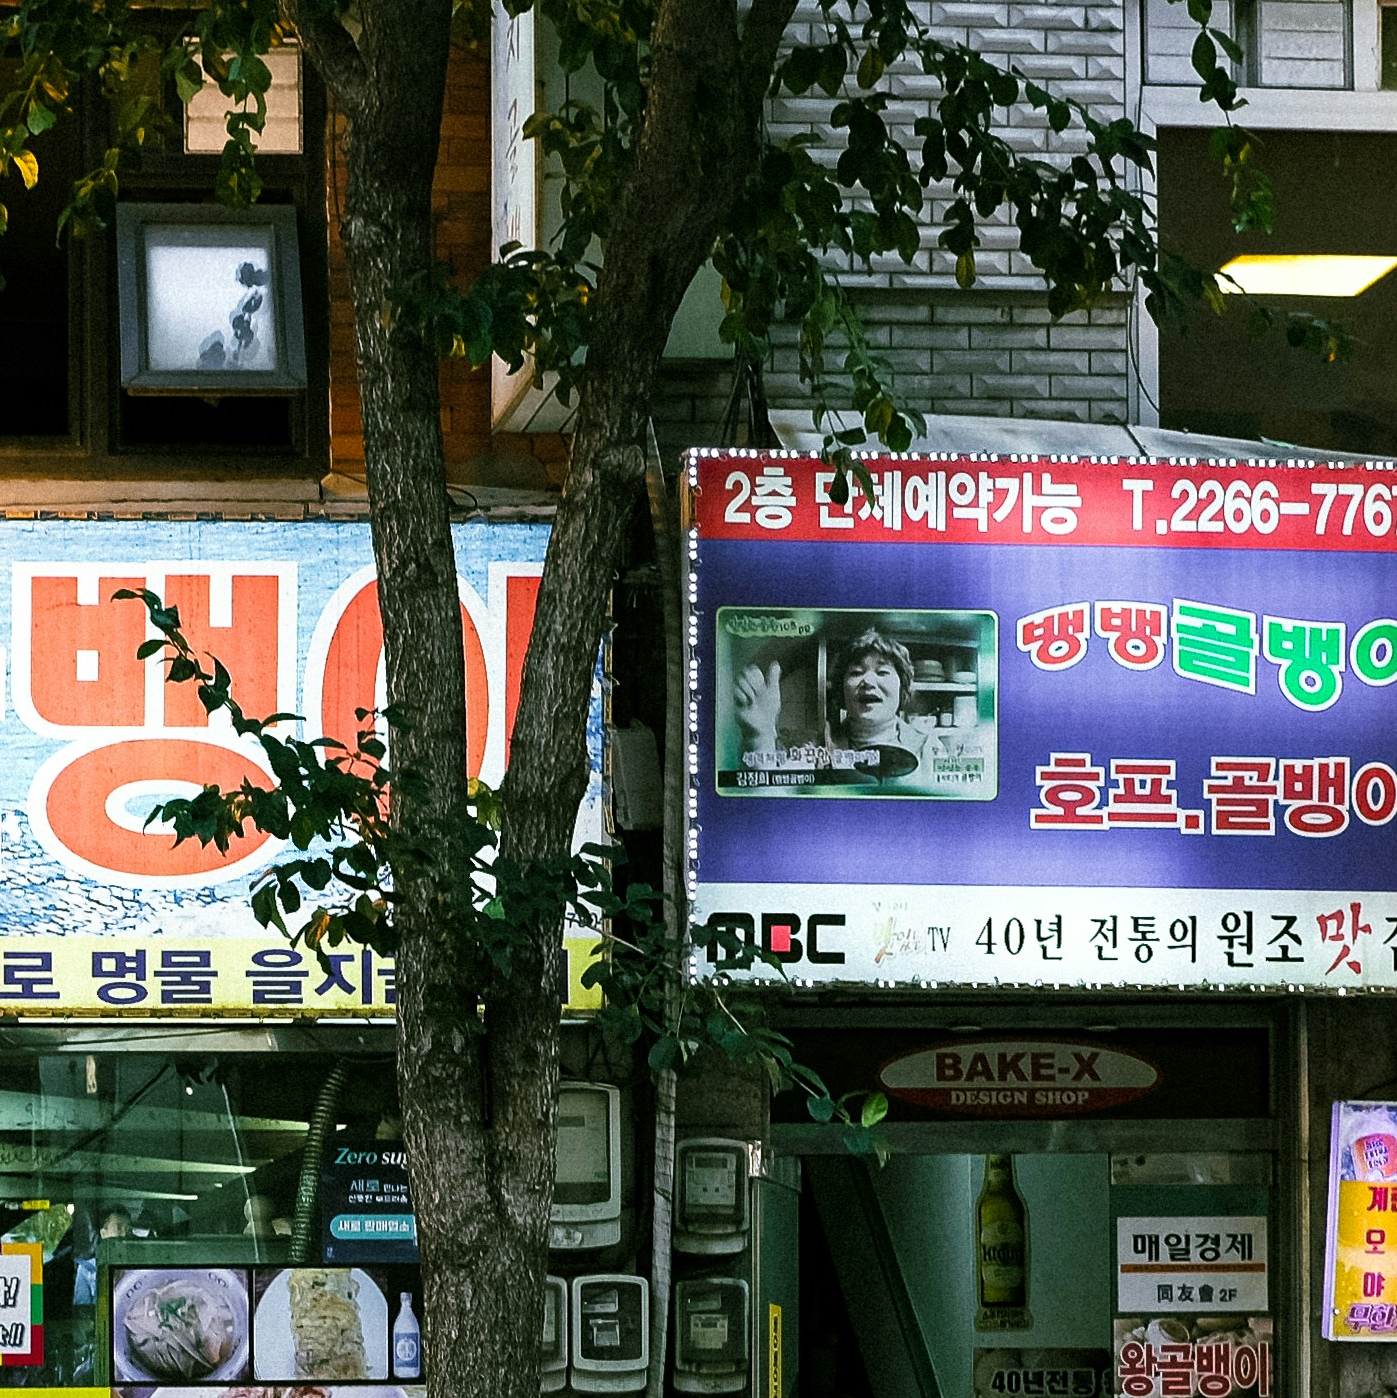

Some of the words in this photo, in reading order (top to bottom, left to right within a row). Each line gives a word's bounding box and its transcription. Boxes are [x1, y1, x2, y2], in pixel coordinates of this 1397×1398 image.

[723, 468, 797, 529] 2층
[974, 914, 1067, 967] 40년
[1088, 915, 1201, 966] 전통의
[89, 948, 218, 1004] 명물
[934, 1051, 1102, 1083] BAKE-X
[950, 1089, 1029, 1106] DESIGN
[1034, 1089, 1090, 1105] SHOP
[334, 1147, 378, 1165] Zero
[1132, 1232, 1255, 1262] 매일경제
[1218, 1288, 1238, 1303] 2F
[1117, 1340, 1270, 1398] 왕골뱅이
